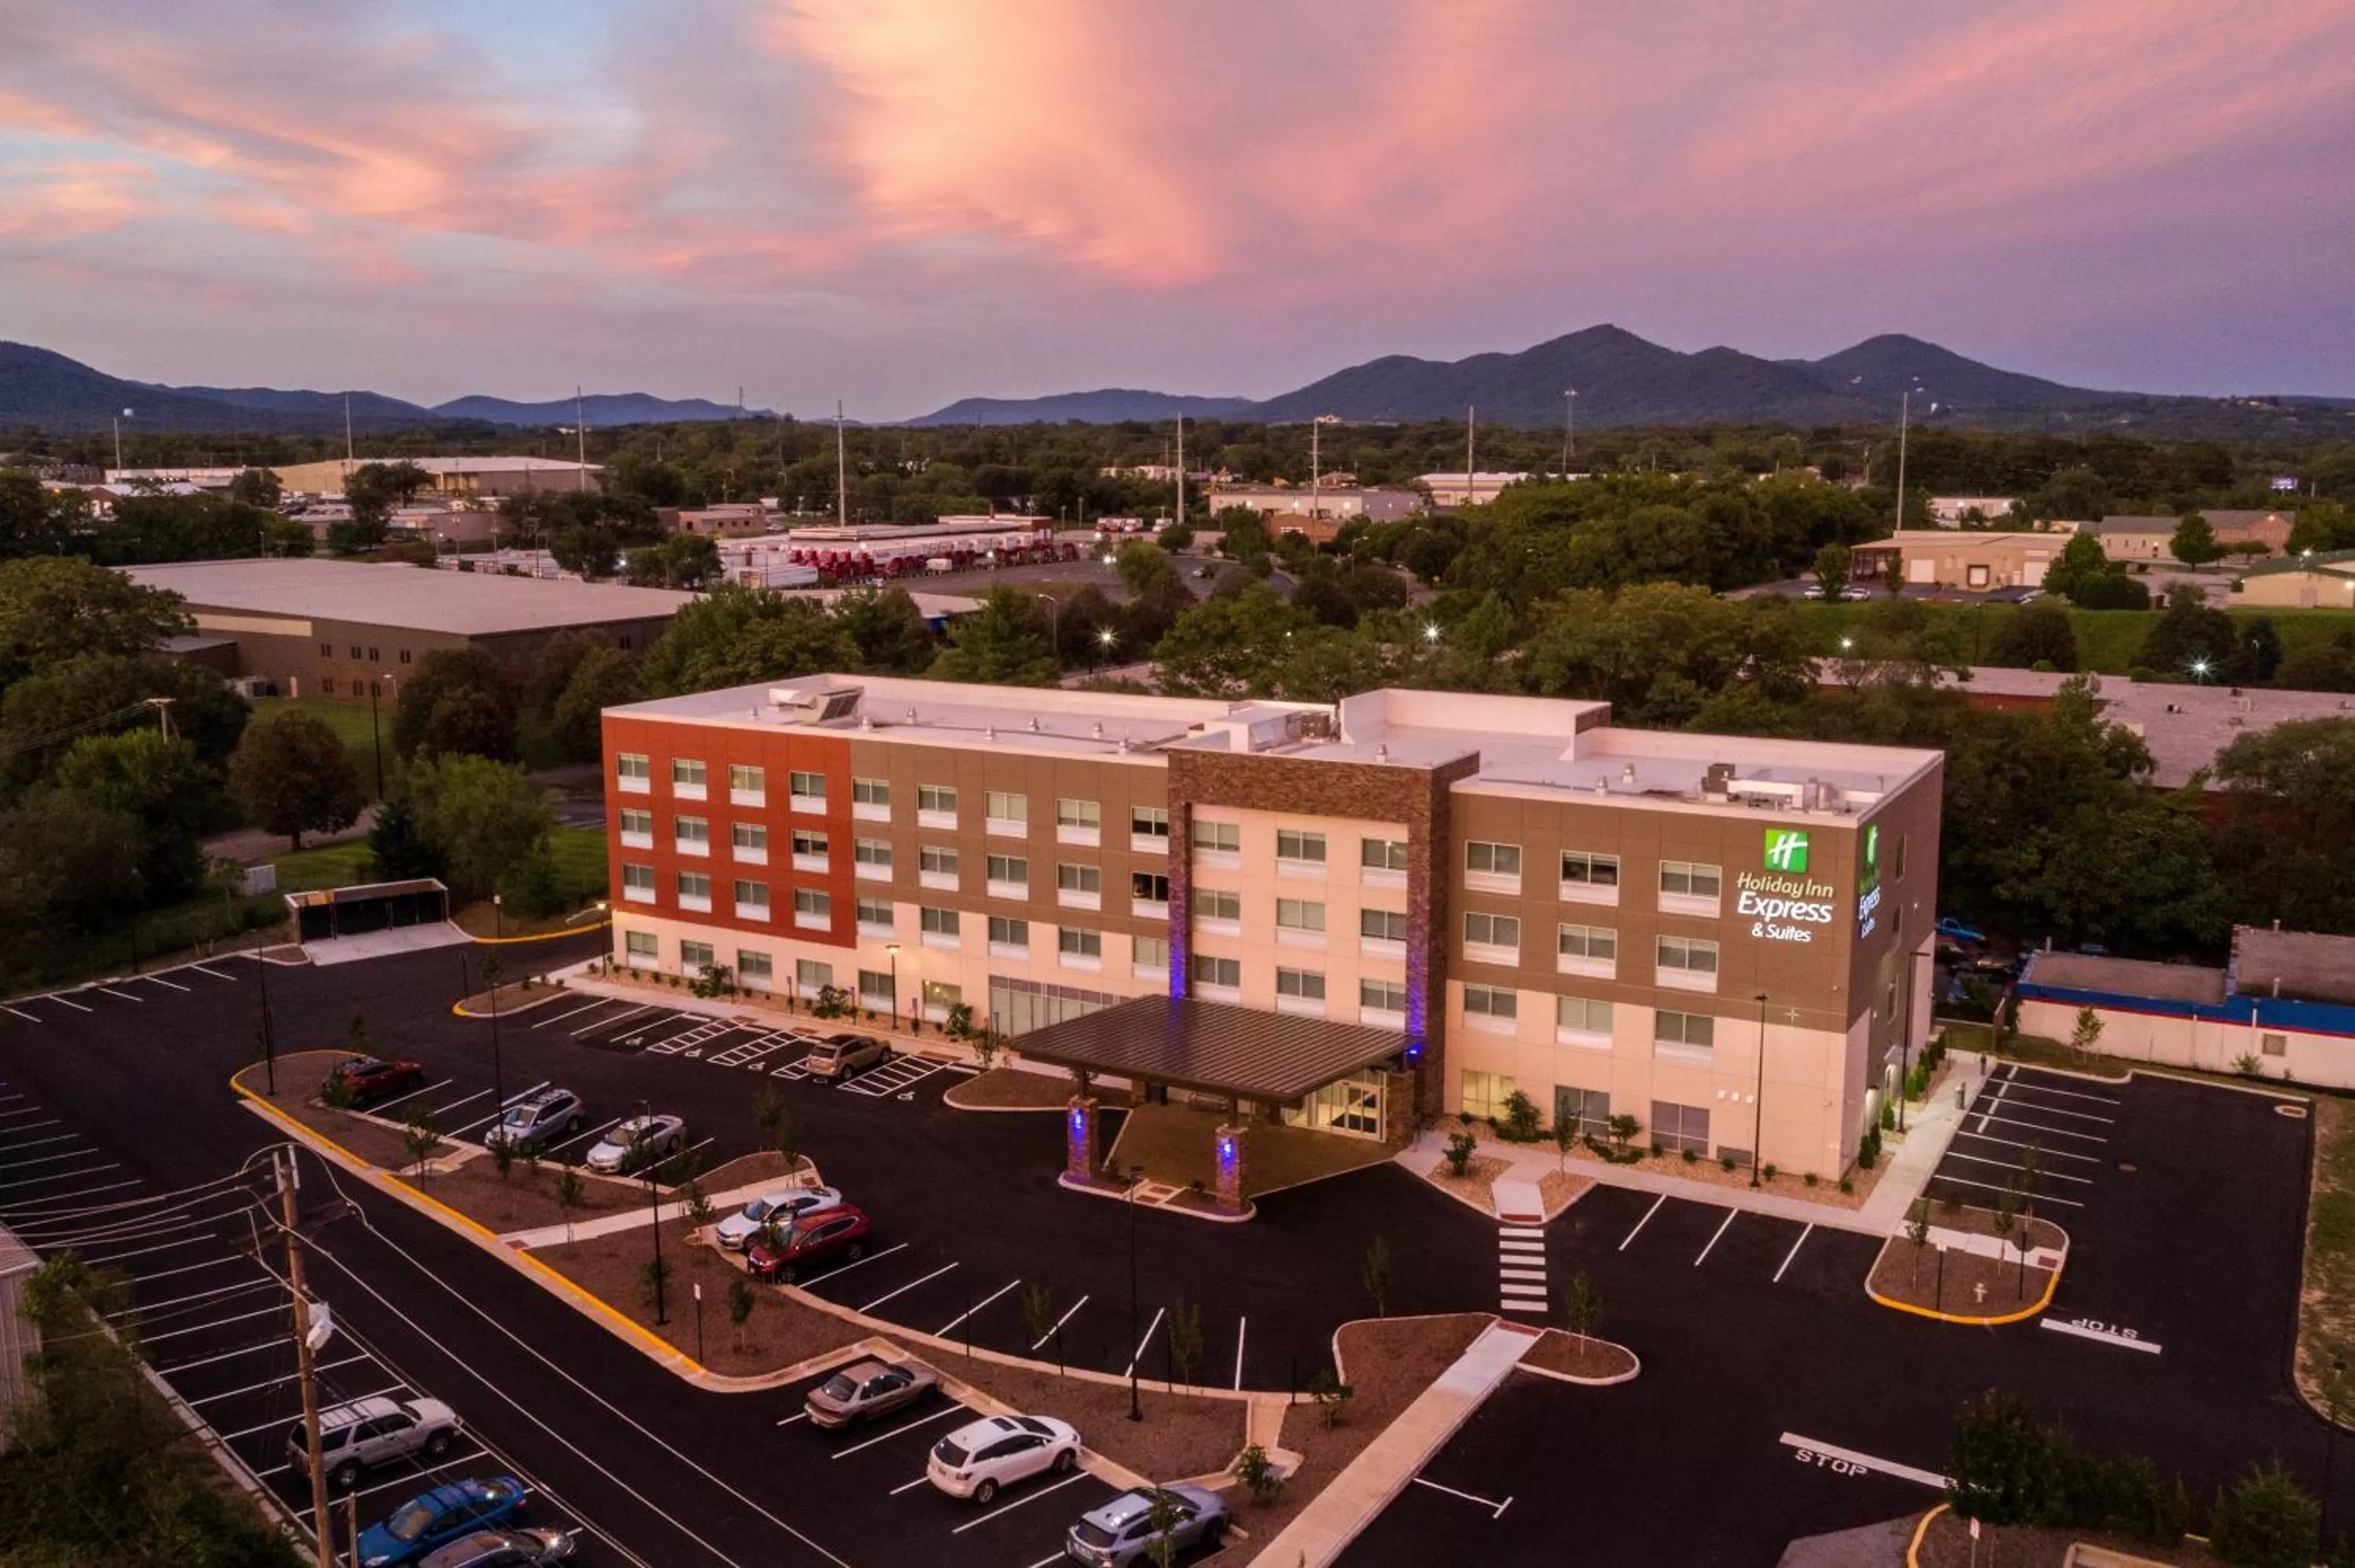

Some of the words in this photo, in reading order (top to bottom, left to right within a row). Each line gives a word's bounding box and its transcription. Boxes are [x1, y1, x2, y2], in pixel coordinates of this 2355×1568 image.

[1737, 873, 1805, 898] Holiday
[1806, 879, 1834, 898] Inn
[1737, 892, 1833, 923] Express
[1751, 923, 1763, 938] &
[1766, 924, 1811, 943] Suites
[2072, 1318, 2138, 1339] STOP
[1795, 1449, 1868, 1476] STOP
